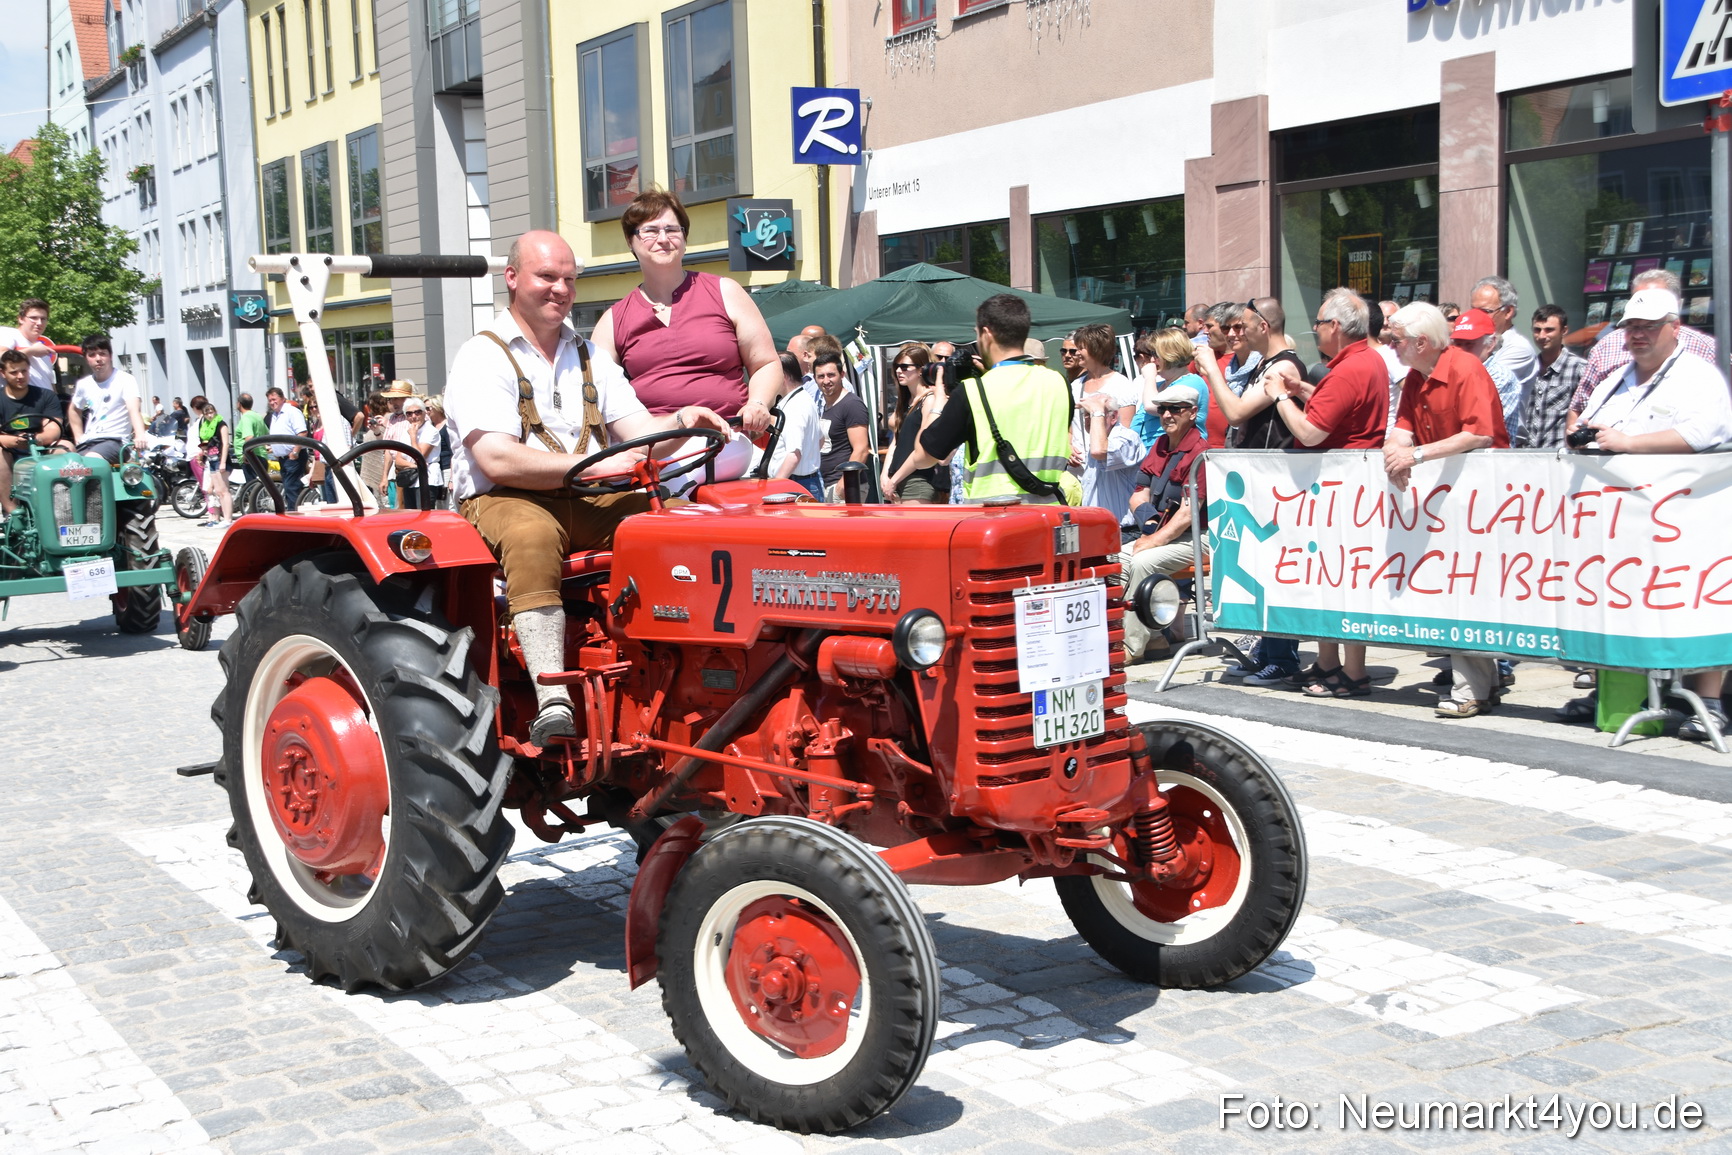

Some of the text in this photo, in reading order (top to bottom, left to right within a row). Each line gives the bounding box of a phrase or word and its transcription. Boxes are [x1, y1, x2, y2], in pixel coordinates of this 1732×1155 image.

[868, 178, 920, 200] Unterer Markt 15
[755, 218, 778, 248] G2
[1353, 484, 1452, 533] UNS
[66, 535, 95, 546] KH 78
[68, 526, 81, 536] NM
[89, 567, 106, 577] 636
[817, 571, 900, 584] INTERNATIONAL
[711, 550, 735, 633] 2
[752, 583, 900, 611] FARMALL D-320
[1066, 600, 1090, 624] 528
[1341, 618, 1445, 640] Service-Line:
[1038, 706, 1044, 714] D
[1052, 687, 1075, 714] NM
[1043, 709, 1099, 742] IH 320
